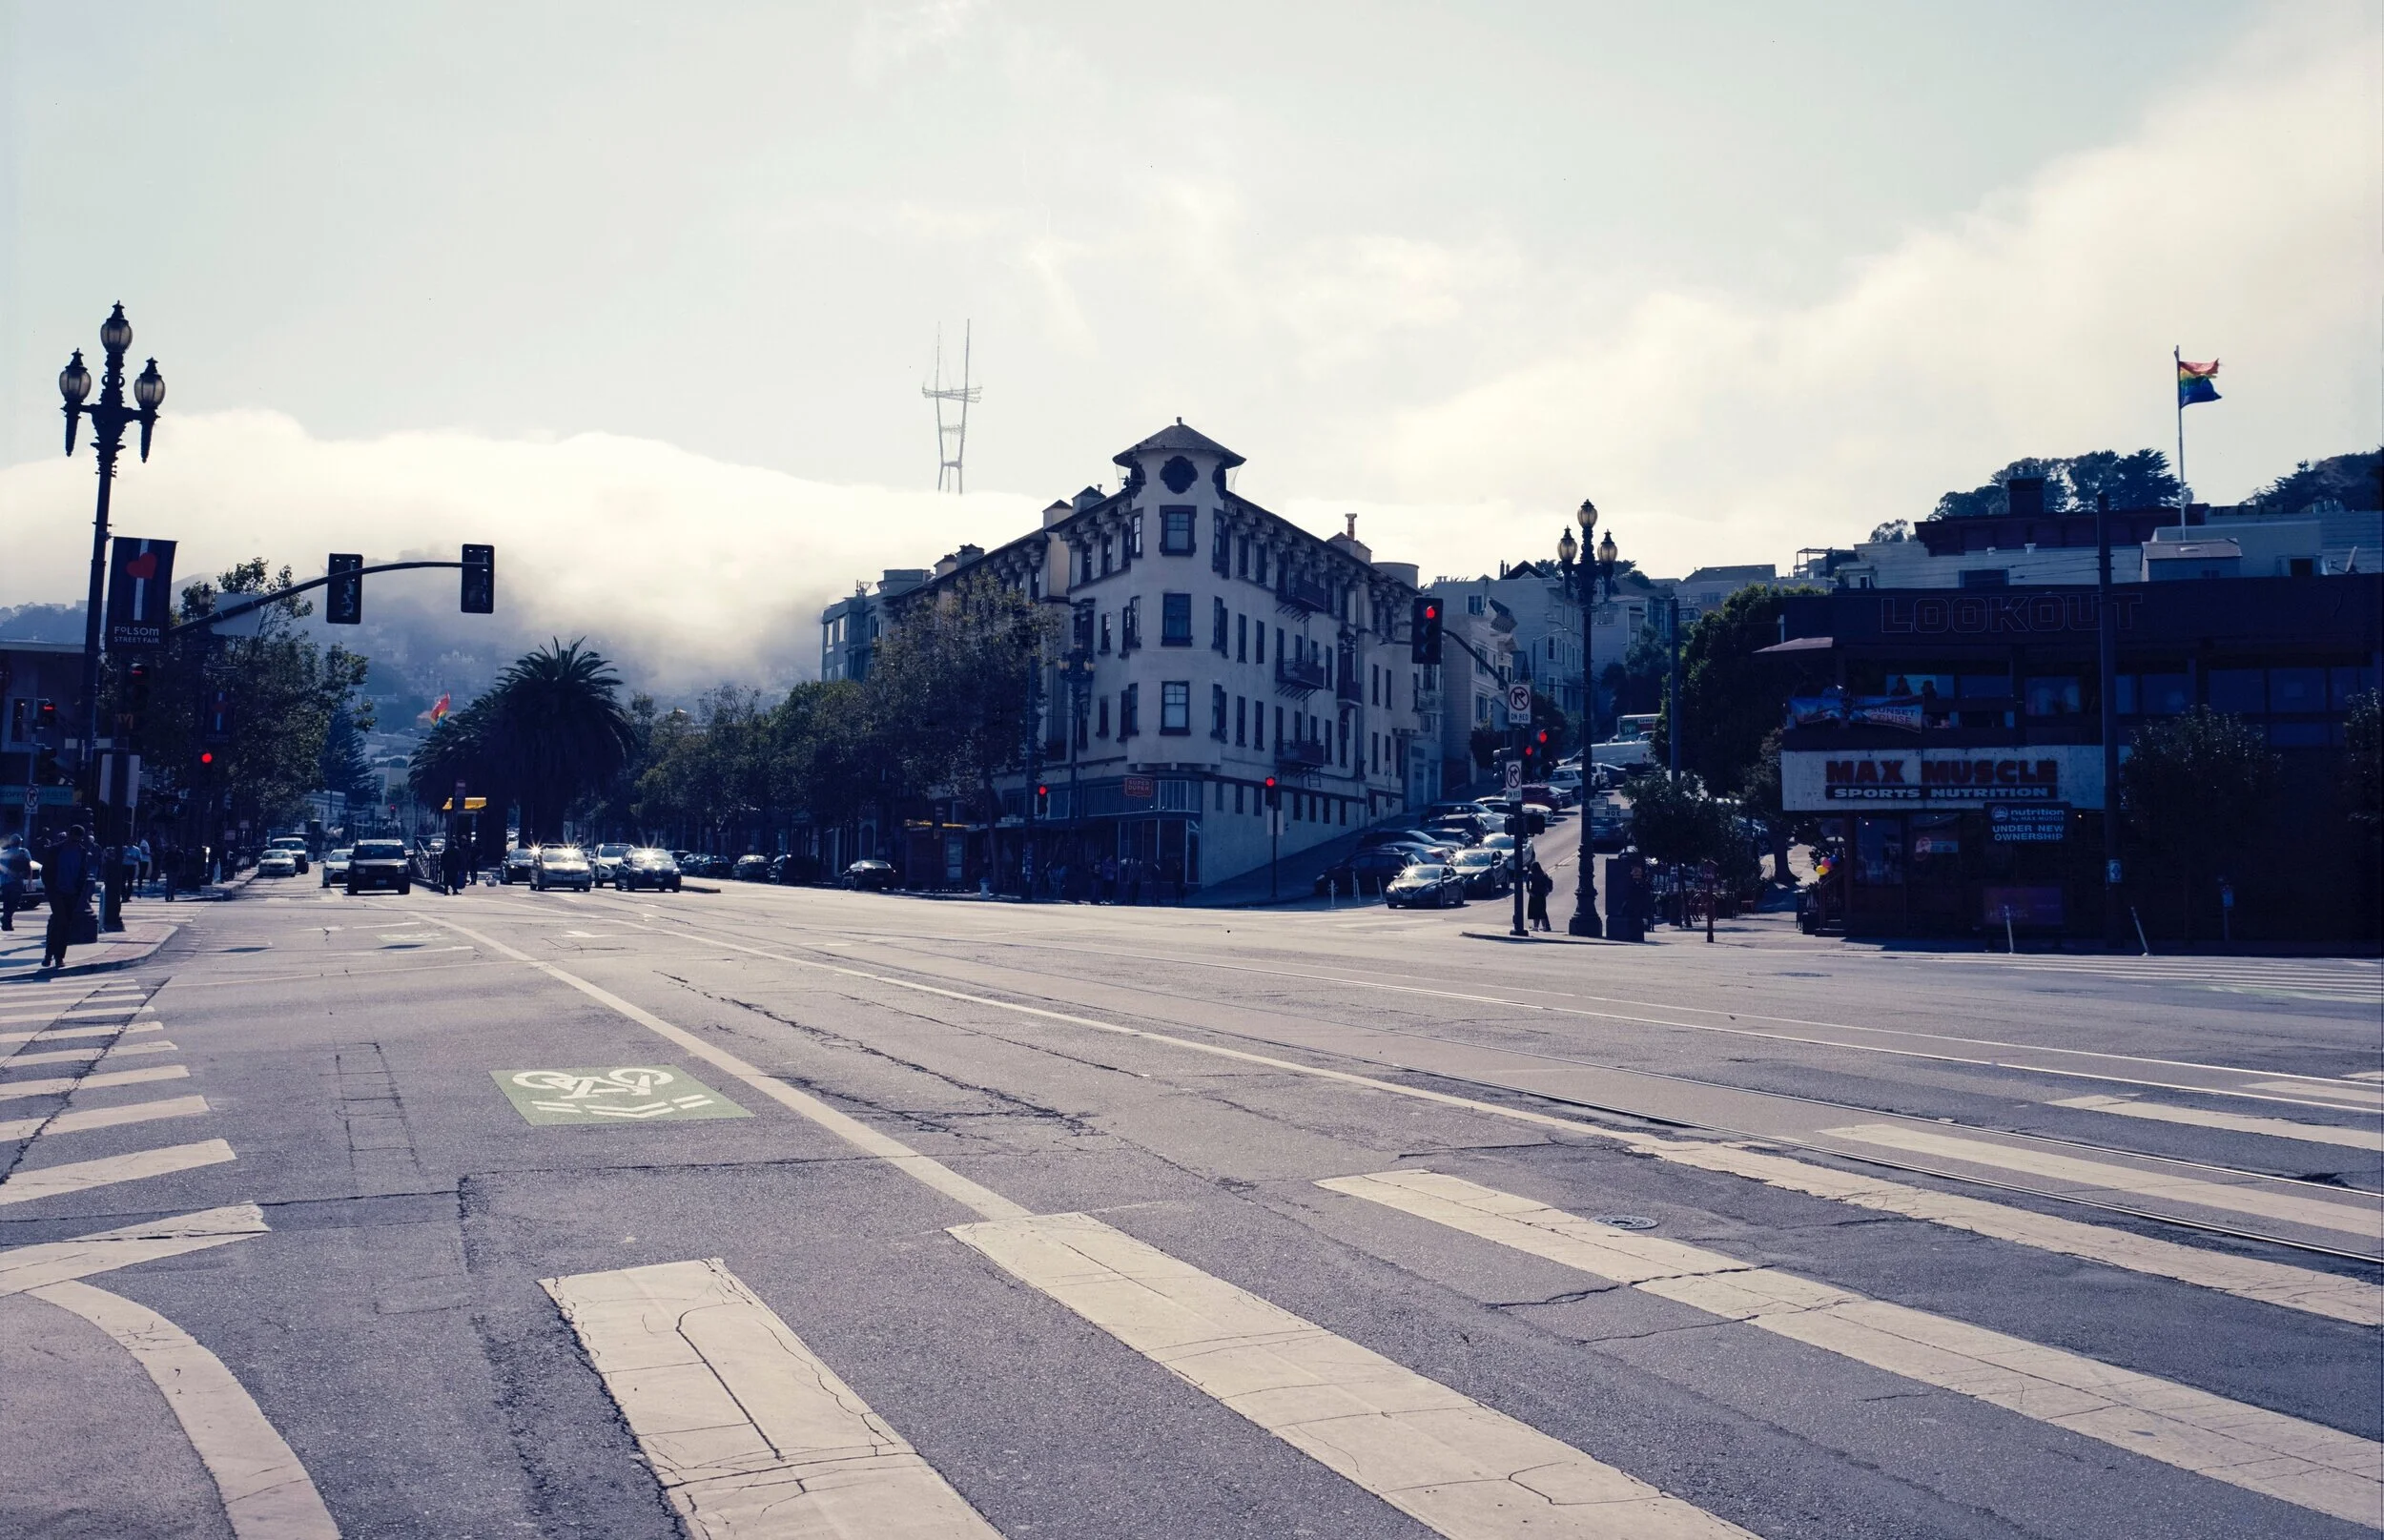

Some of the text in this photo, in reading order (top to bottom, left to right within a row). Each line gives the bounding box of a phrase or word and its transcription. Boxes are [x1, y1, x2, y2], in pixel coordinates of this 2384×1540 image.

[1881, 593, 2143, 633] LOOKOUT
[114, 626, 159, 636] FOLSOM
[1871, 706, 1916, 716] SUNSET
[1511, 712, 1529, 721] ON RED
[1826, 760, 2057, 783] MAX MUSCLE
[1834, 788, 2048, 798] SPORTS NUTRITION
[2011, 808, 2065, 816] nutrition
[1994, 832, 2064, 841] OWNERSHIP
